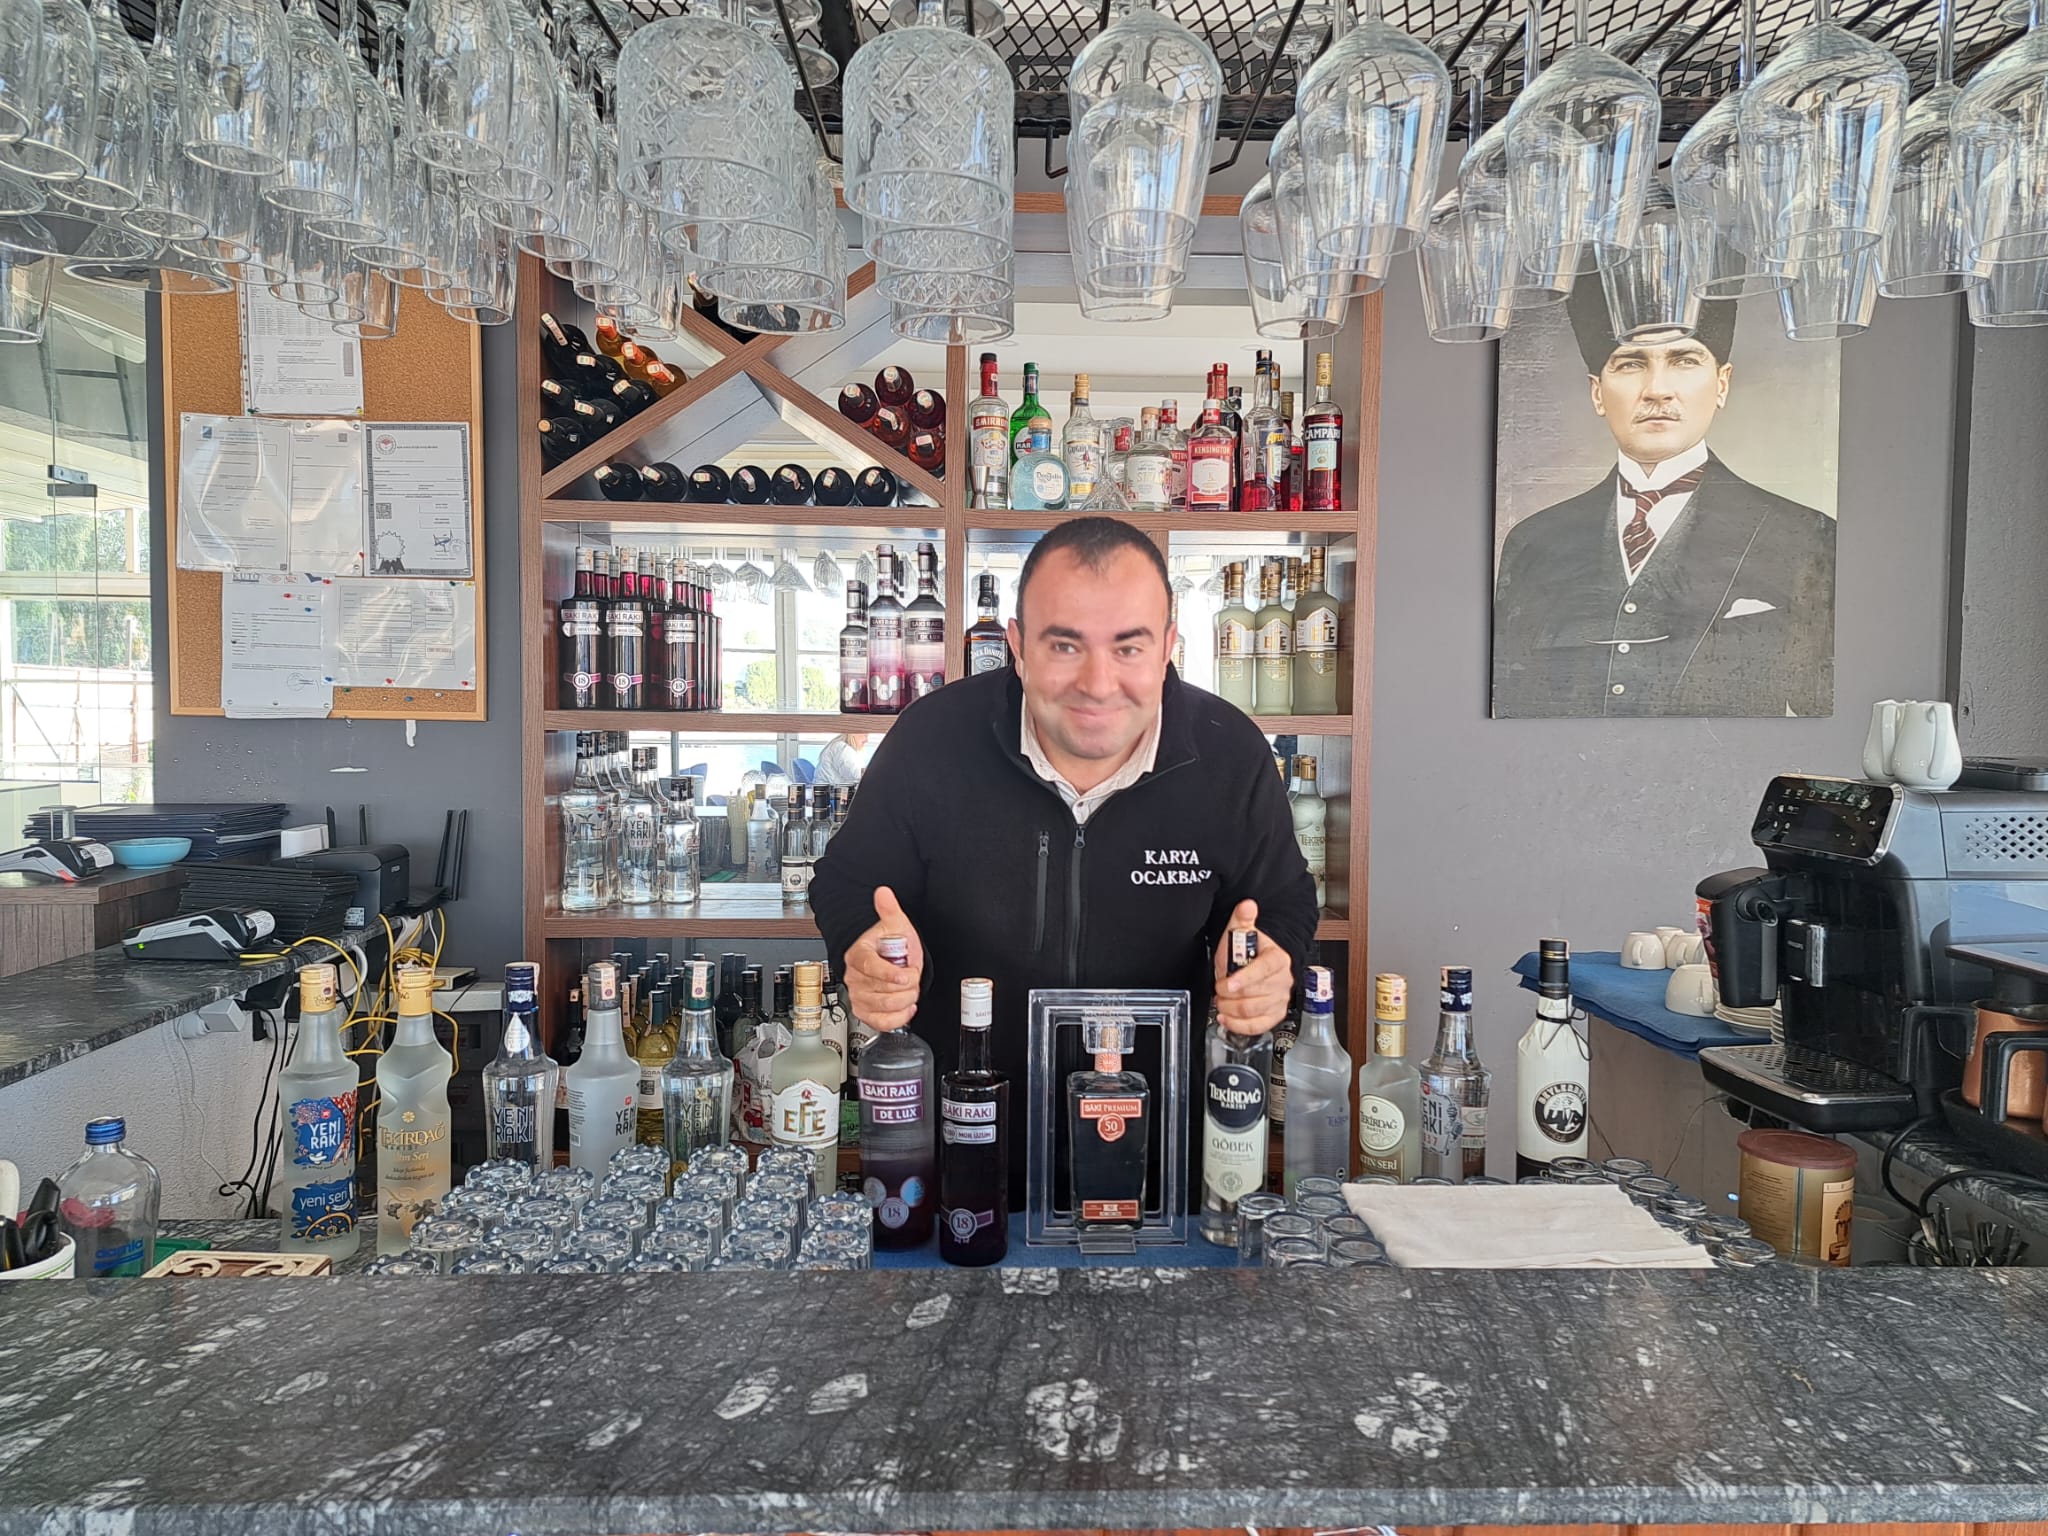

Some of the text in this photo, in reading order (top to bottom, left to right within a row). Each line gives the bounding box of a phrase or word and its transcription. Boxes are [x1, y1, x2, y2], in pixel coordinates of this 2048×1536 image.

[1145, 850, 1200, 865] KARYA
[890, 1085, 918, 1097] RAKI
[1209, 1082, 1261, 1105] TEKİRDAĞ
[783, 1101, 827, 1138] EFE
[896, 1108, 918, 1119] LUX
[964, 1107, 993, 1119] RAKI
[309, 1117, 342, 1137] YENİ
[379, 1121, 446, 1147] TEKİRDAĞ
[310, 1133, 341, 1150] RAKI
[1212, 1138, 1254, 1153] GÖBEK
[300, 1192, 327, 1210] yeni
